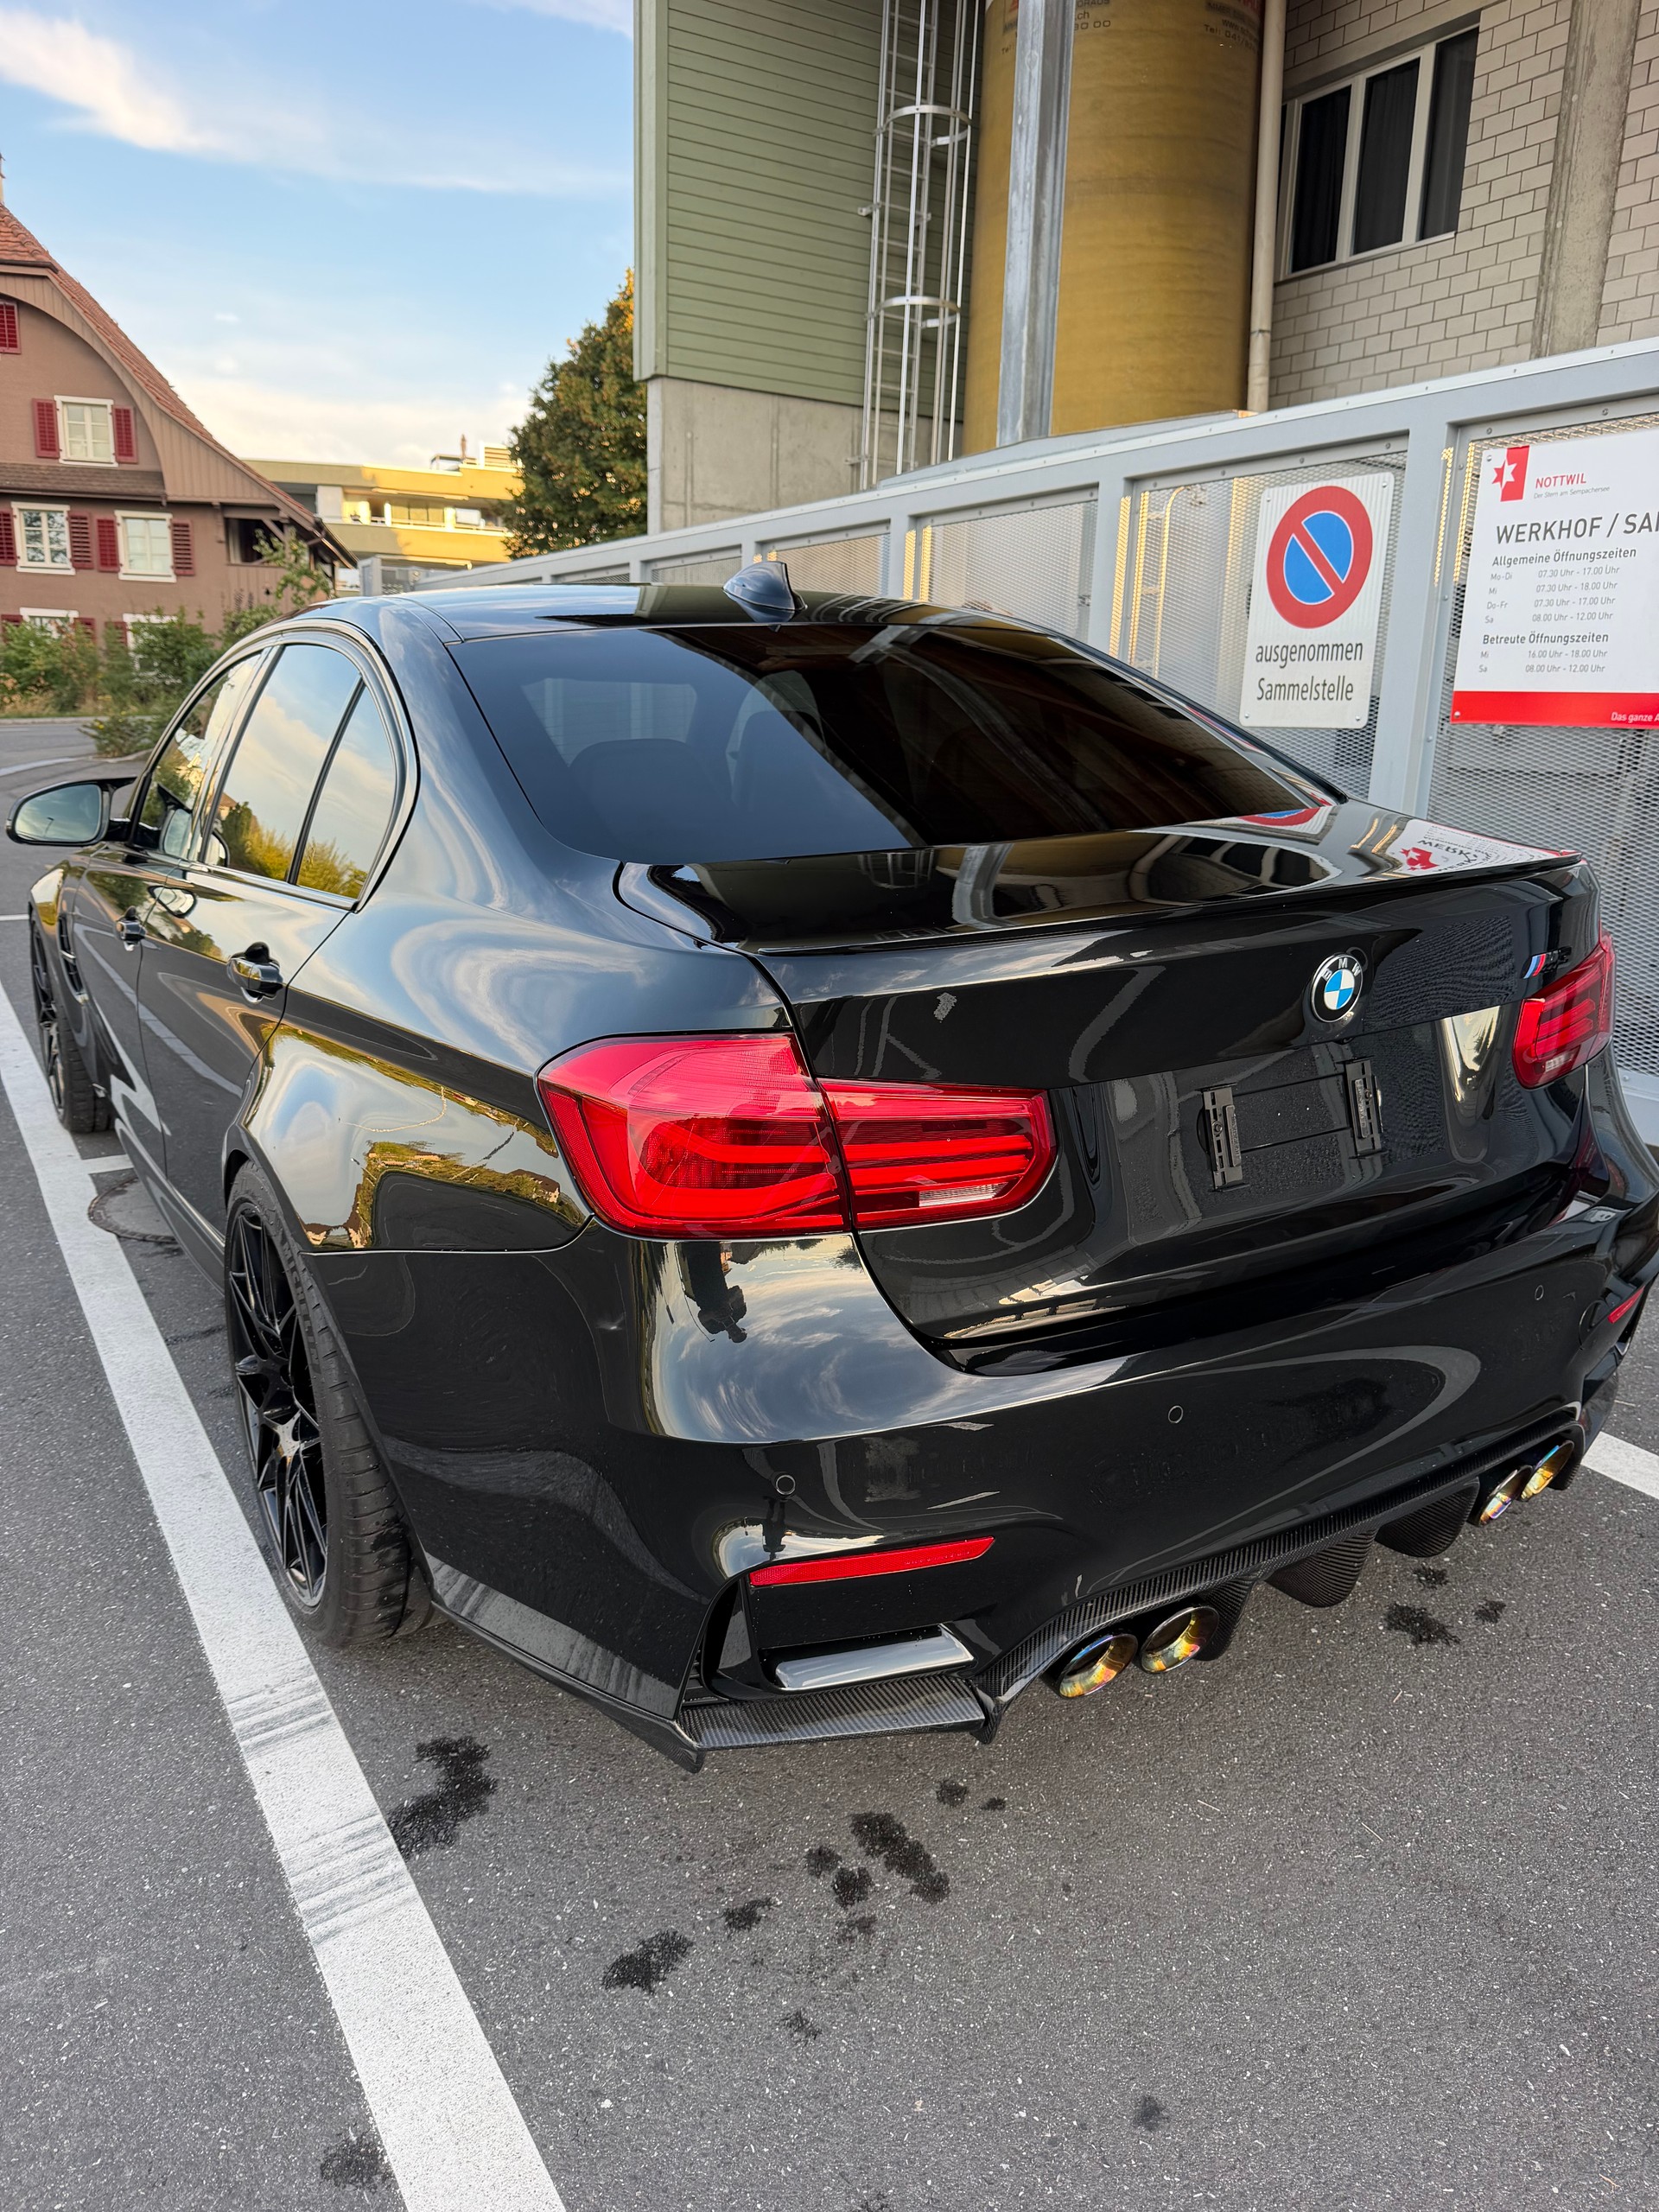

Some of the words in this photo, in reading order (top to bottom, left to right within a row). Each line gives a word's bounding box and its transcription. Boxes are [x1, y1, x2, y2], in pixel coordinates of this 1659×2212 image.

[1535, 473, 1586, 489] NOTTWIL
[1570, 486, 1611, 496] Sempachersee
[1497, 516, 1603, 544] WERKHOF
[1605, 512, 1620, 538] /
[1623, 512, 1659, 534] SA
[1491, 553, 1551, 569] Allgemeine
[1553, 547, 1637, 563] Öffnungszeiten
[1537, 569, 1559, 579] 07.30
[1560, 568, 1574, 577] Uhr
[1582, 566, 1604, 576] 17.00
[1605, 564, 1621, 575] Uhr
[1488, 587, 1497, 595] Mi
[1535, 584, 1556, 594] 07.30
[1557, 583, 1573, 593] Uhr
[1580, 582, 1601, 591] 18.00
[1602, 581, 1618, 590] Uhr
[1534, 599, 1554, 608] 07.30
[1555, 598, 1571, 607] Uhr
[1579, 596, 1599, 607] 17.00
[1600, 596, 1616, 606] Uhr
[1484, 614, 1494, 624] Sa
[1532, 613, 1553, 623] 08.00
[1554, 613, 1568, 622] Uhr
[1576, 612, 1597, 621] 12.00
[1598, 611, 1614, 620] Uhr
[1482, 633, 1526, 645] Betreute
[1529, 630, 1609, 646] Öffnungszeiten
[1255, 642, 1363, 669] ausgenommen
[1480, 650, 1490, 658] Mi
[1528, 650, 1548, 658] 16.00
[1548, 649, 1563, 658] Uhr
[1571, 649, 1592, 658] 18.00
[1592, 648, 1608, 658] Uhr
[1478, 664, 1488, 673] Sa
[1525, 664, 1546, 673] 08.00
[1547, 664, 1561, 673] Uhr
[1568, 664, 1589, 673] 12.00
[1590, 664, 1605, 673] Uhr
[1256, 675, 1354, 701] Sammelstelle
[1611, 711, 1627, 721] Das
[1628, 714, 1653, 724] ganze
[1320, 957, 1362, 982] BMW
[282, 1241, 320, 1363] MICHELIN
